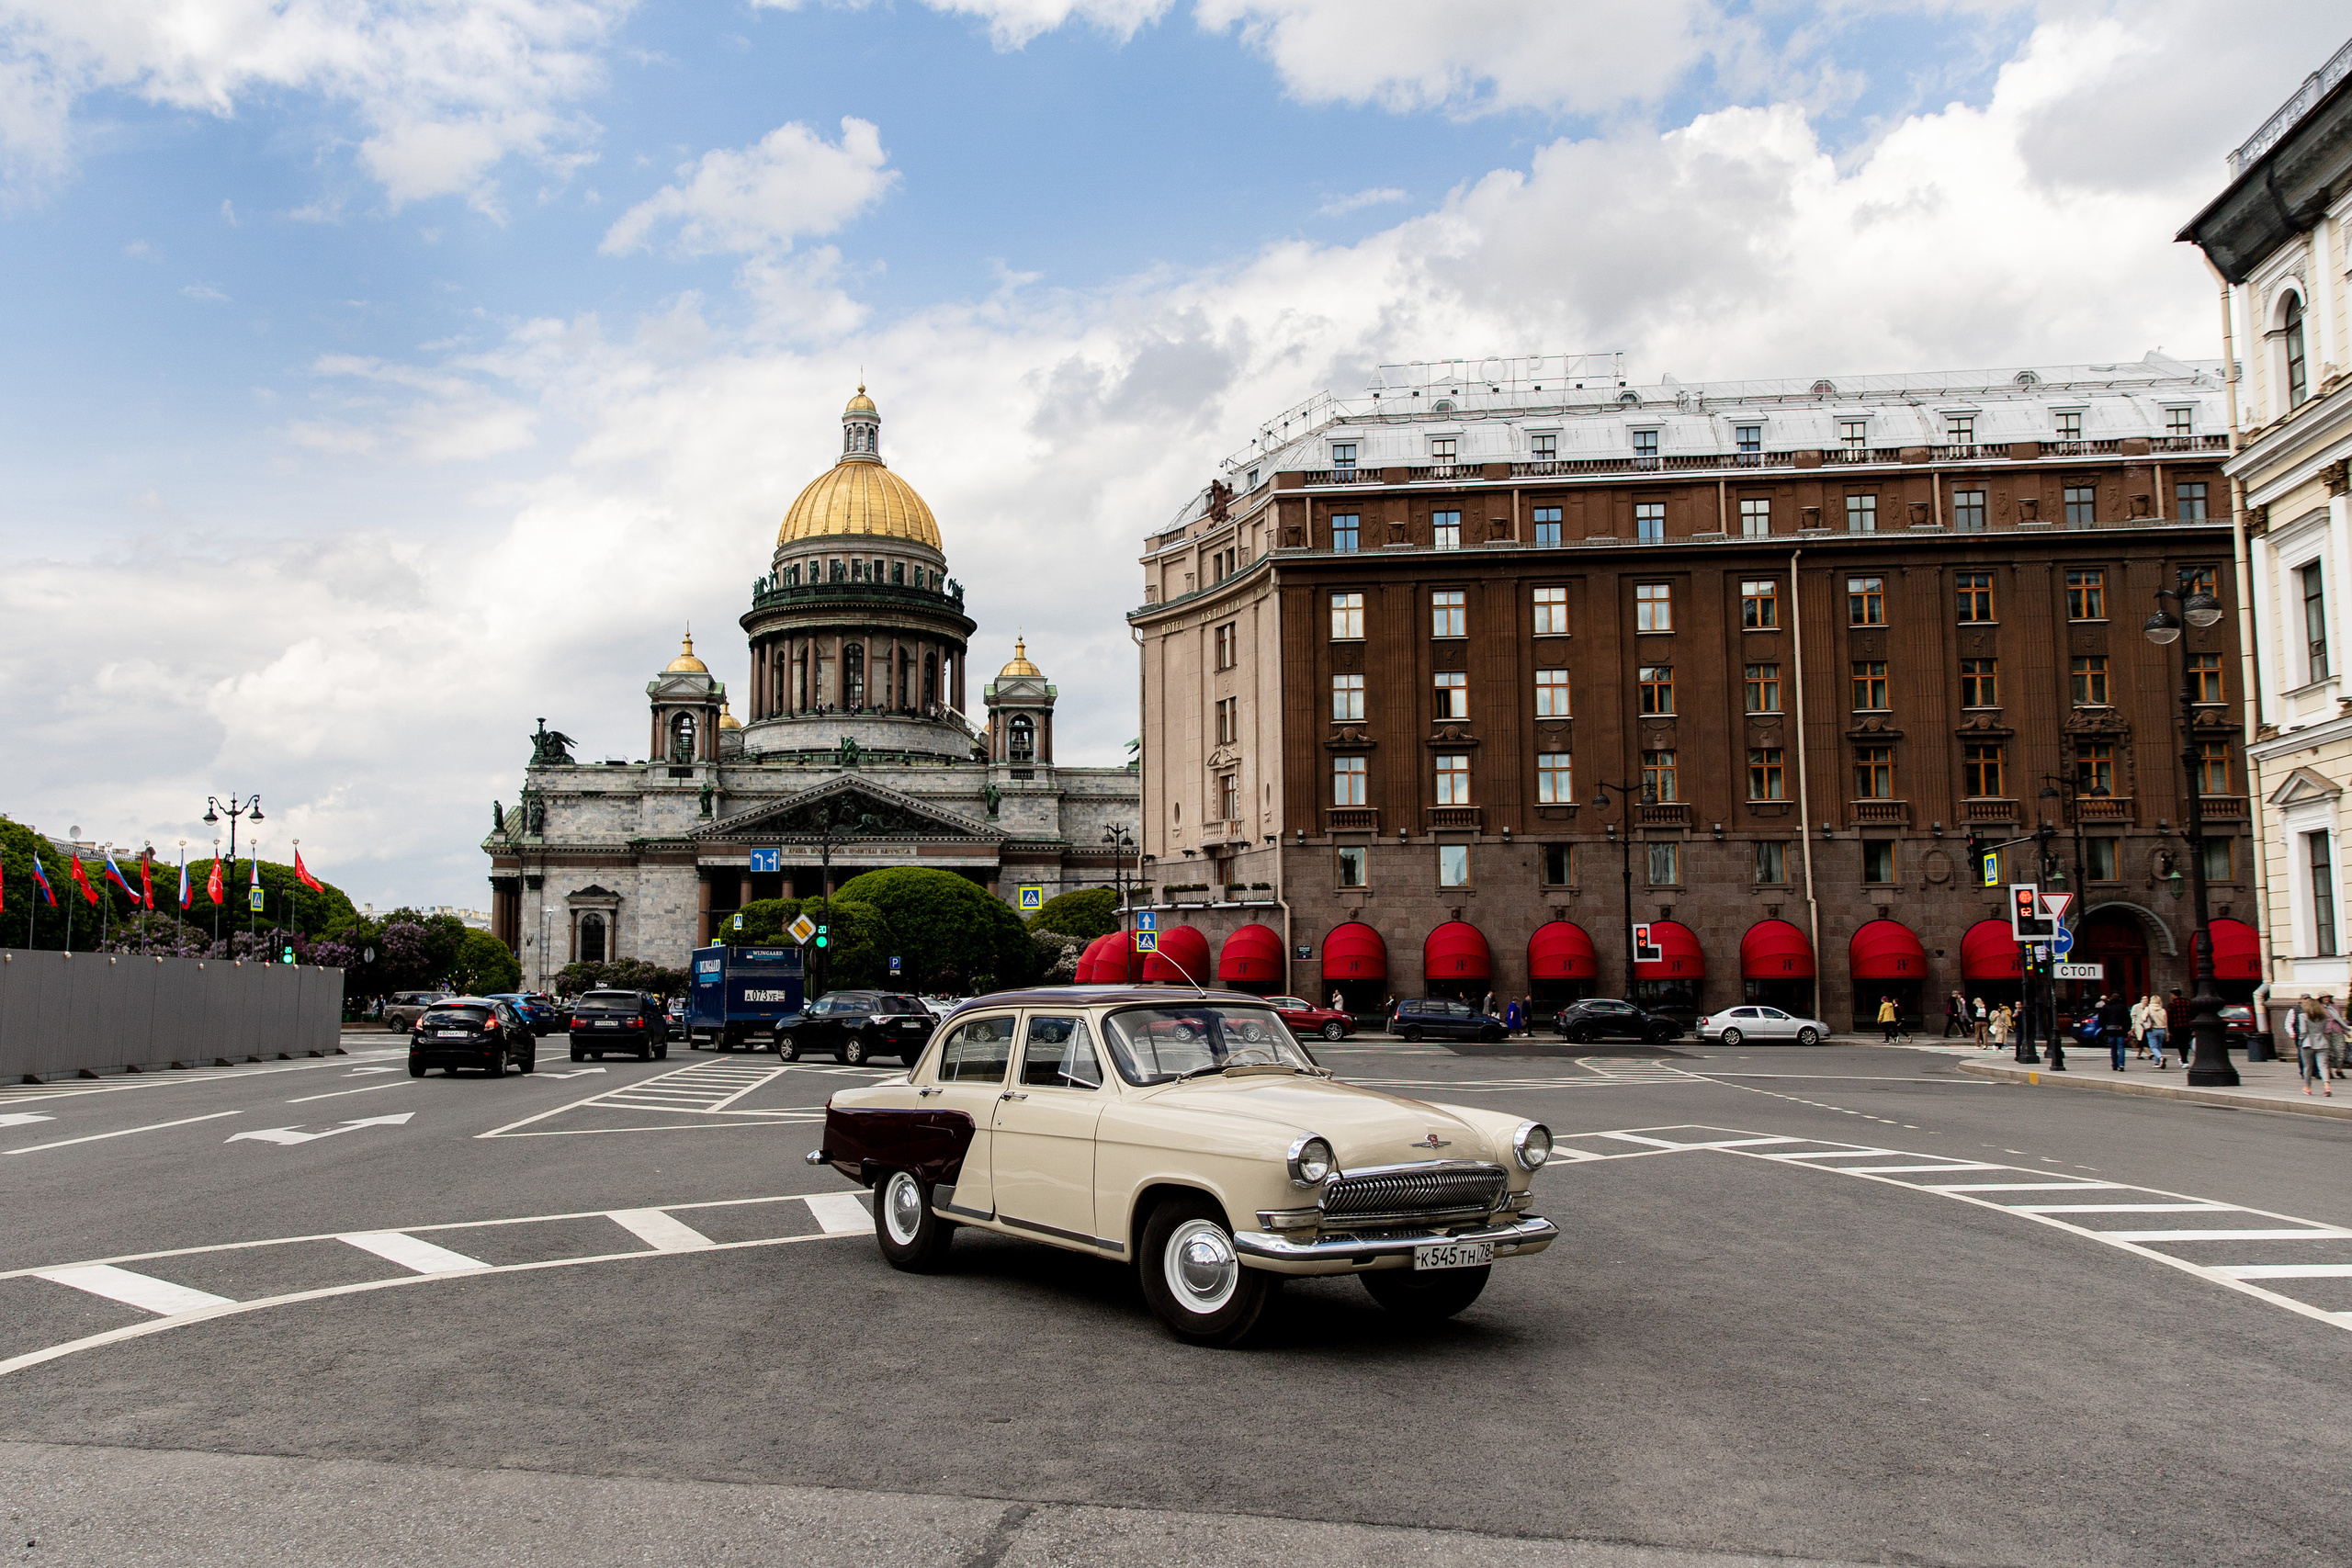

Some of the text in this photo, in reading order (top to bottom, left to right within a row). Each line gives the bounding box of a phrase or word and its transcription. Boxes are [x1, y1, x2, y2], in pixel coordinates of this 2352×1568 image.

[1363, 349, 1627, 391] АСТОРИЯ
[1161, 620, 1184, 635] HOTEL
[1200, 599, 1241, 624] ASTORIA
[2020, 907, 2032, 917] 62
[818, 925, 827, 934] 20
[1638, 939, 1647, 947] 62
[2061, 966, 2096, 976] СТОП
[1420, 1244, 1491, 1267] К545ТН 78
